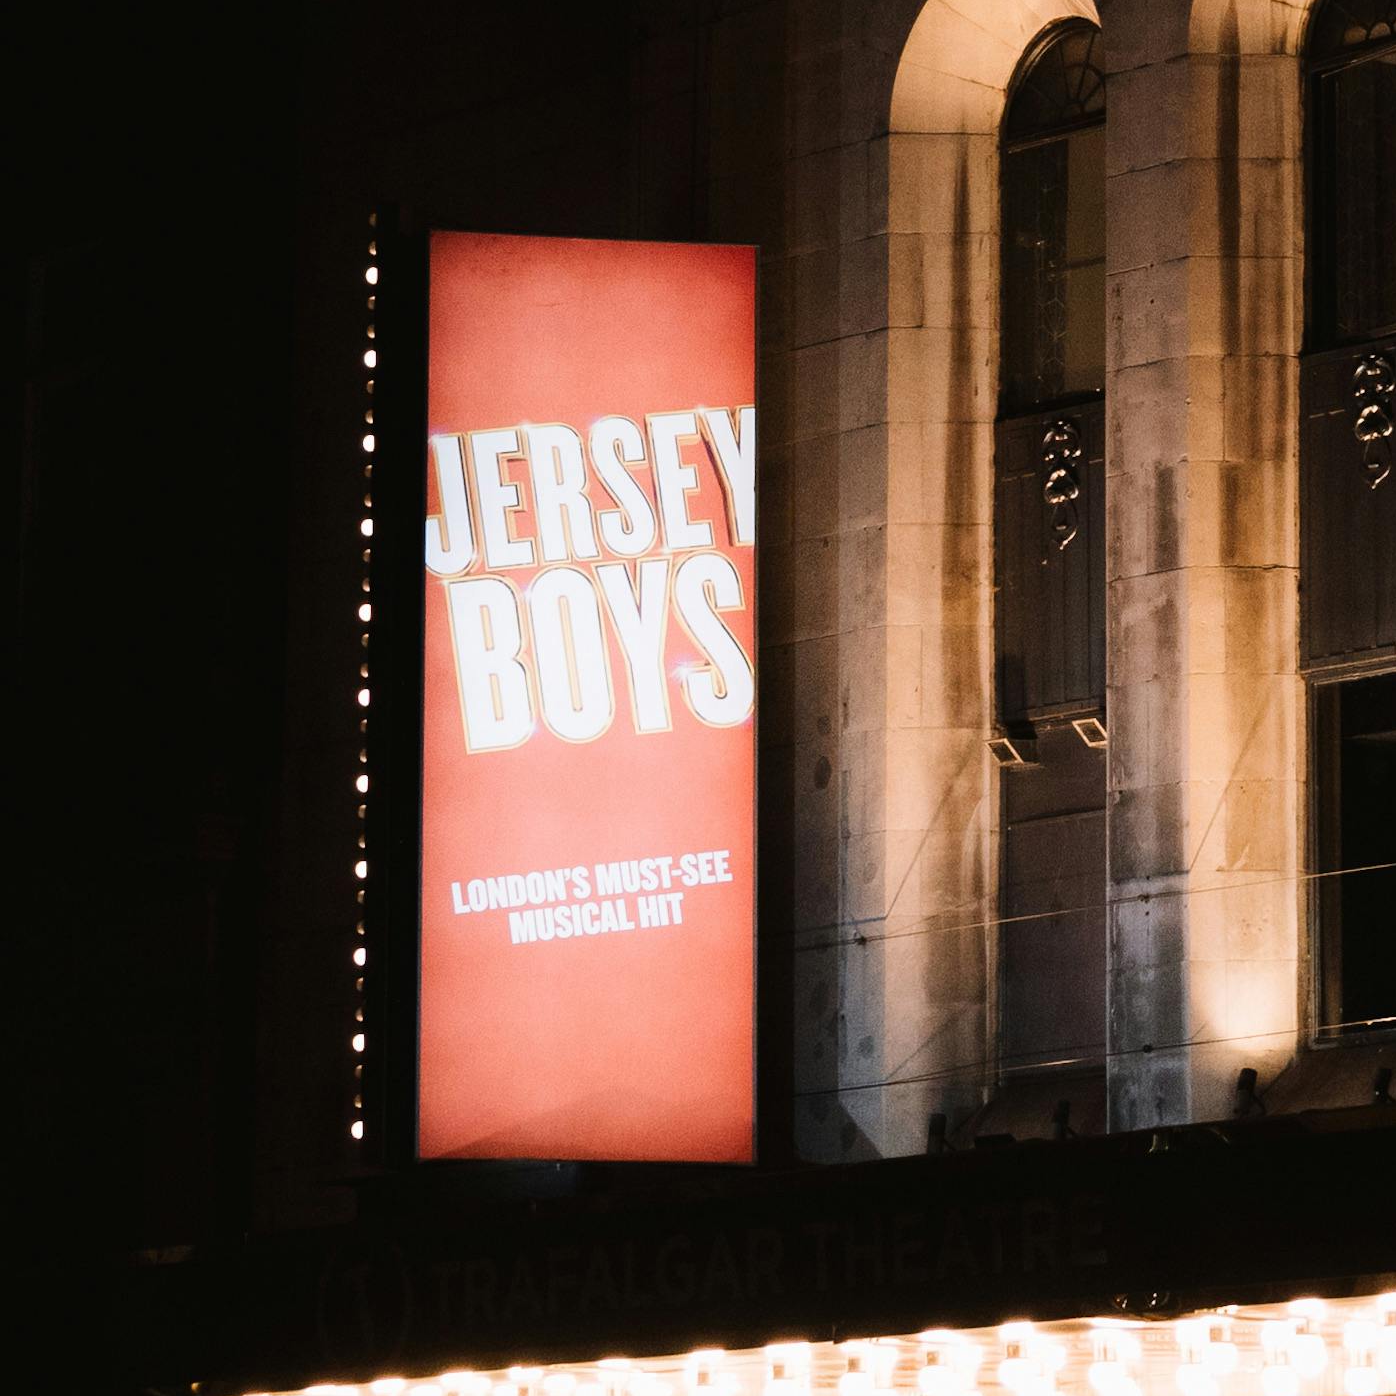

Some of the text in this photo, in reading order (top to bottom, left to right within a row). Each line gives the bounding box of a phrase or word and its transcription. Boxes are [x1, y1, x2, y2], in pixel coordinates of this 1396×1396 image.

[425, 407, 755, 577] JERSEY
[449, 551, 754, 755] BOYS
[450, 849, 733, 915] LONDON'S MUST-SEE
[508, 891, 684, 945] MUSICAL HIT
